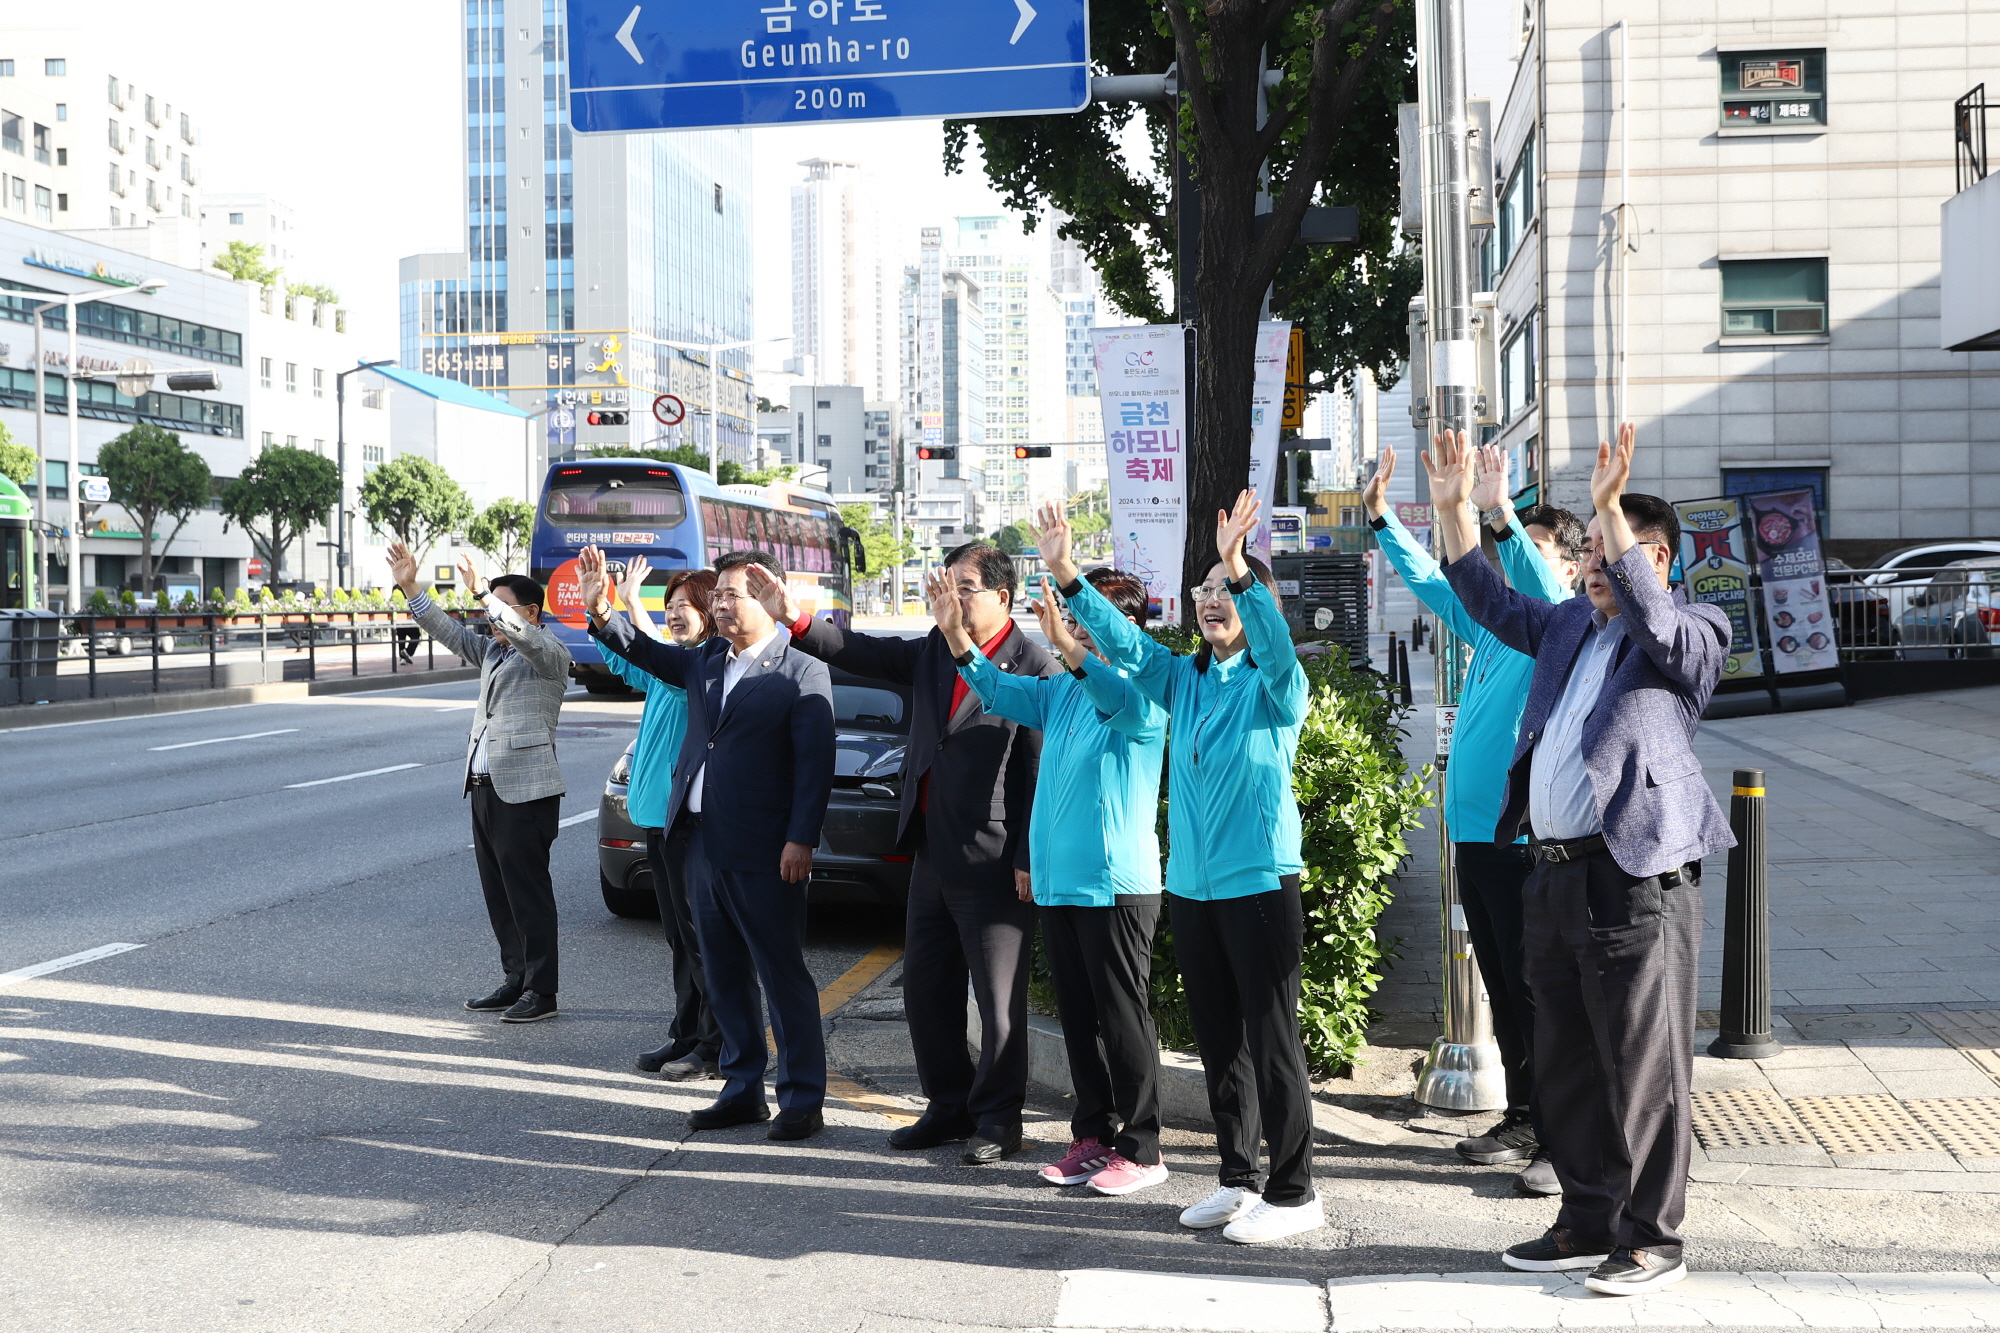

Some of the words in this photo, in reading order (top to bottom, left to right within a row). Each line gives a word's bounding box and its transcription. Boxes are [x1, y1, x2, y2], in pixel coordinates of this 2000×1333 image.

[741, 36, 910, 68] Geumha-ro
[795, 87, 866, 110] 200m
[1779, 103, 1810, 117] 체육관
[605, 390, 628, 404] 내과
[1120, 401, 1170, 426] 금천
[1110, 429, 1180, 453] 하모니
[1126, 458, 1173, 482] 축제
[1687, 511, 1727, 520] 아이센스
[1700, 521, 1721, 530] 리그
[566, 532, 588, 544] 인터넷
[589, 532, 611, 544] 검색창
[1693, 528, 1734, 561] PC
[1774, 547, 1818, 565] 수제요리
[1772, 561, 1819, 577] 전문PC방
[1696, 577, 1742, 593] OPEN
